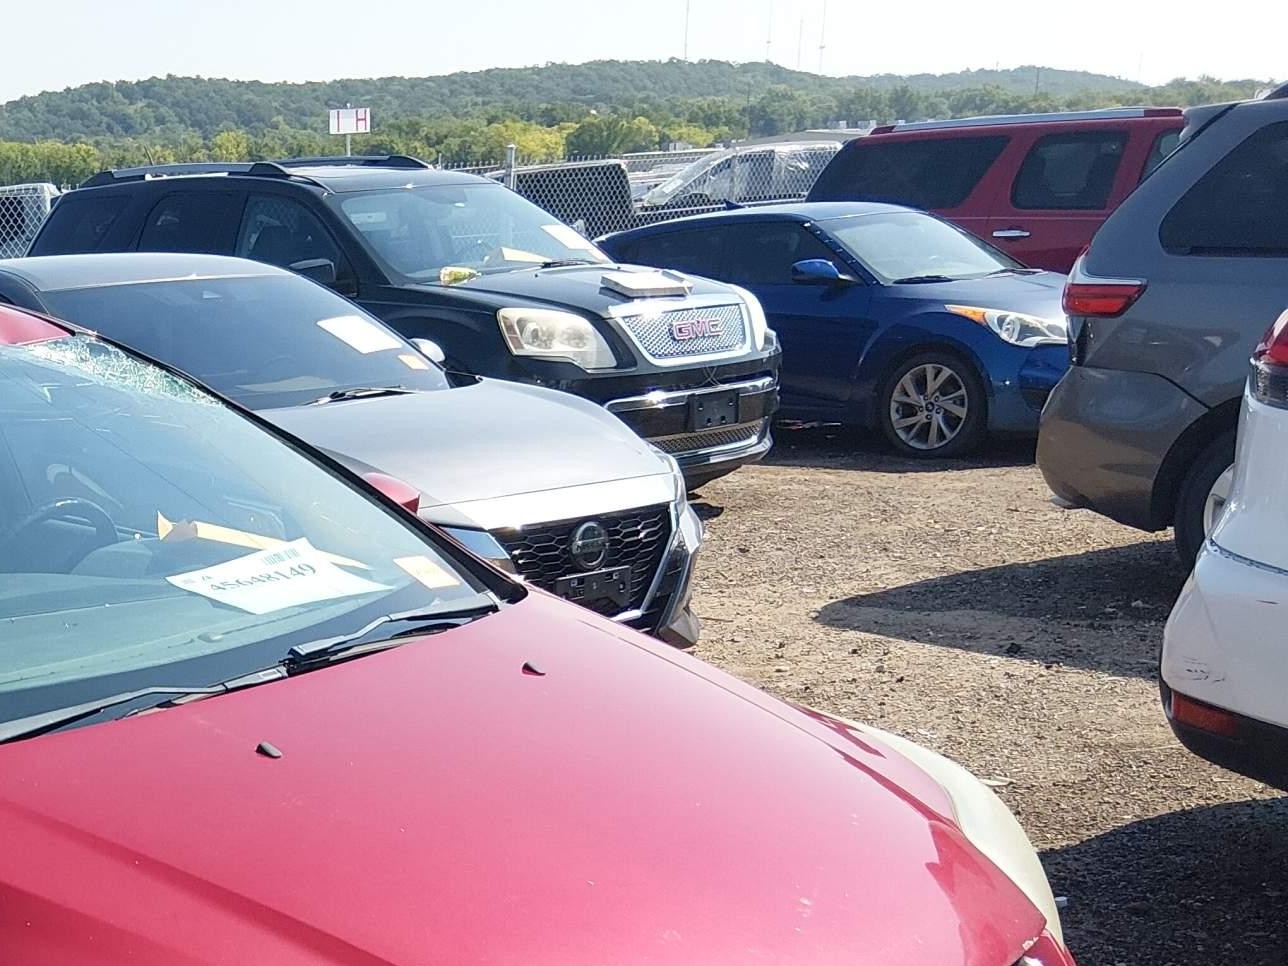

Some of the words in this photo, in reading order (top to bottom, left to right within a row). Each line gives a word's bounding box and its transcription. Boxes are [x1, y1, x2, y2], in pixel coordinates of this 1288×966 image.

[355, 109, 367, 131] H
[673, 318, 724, 340] GMC
[209, 562, 317, 593] 45648149
